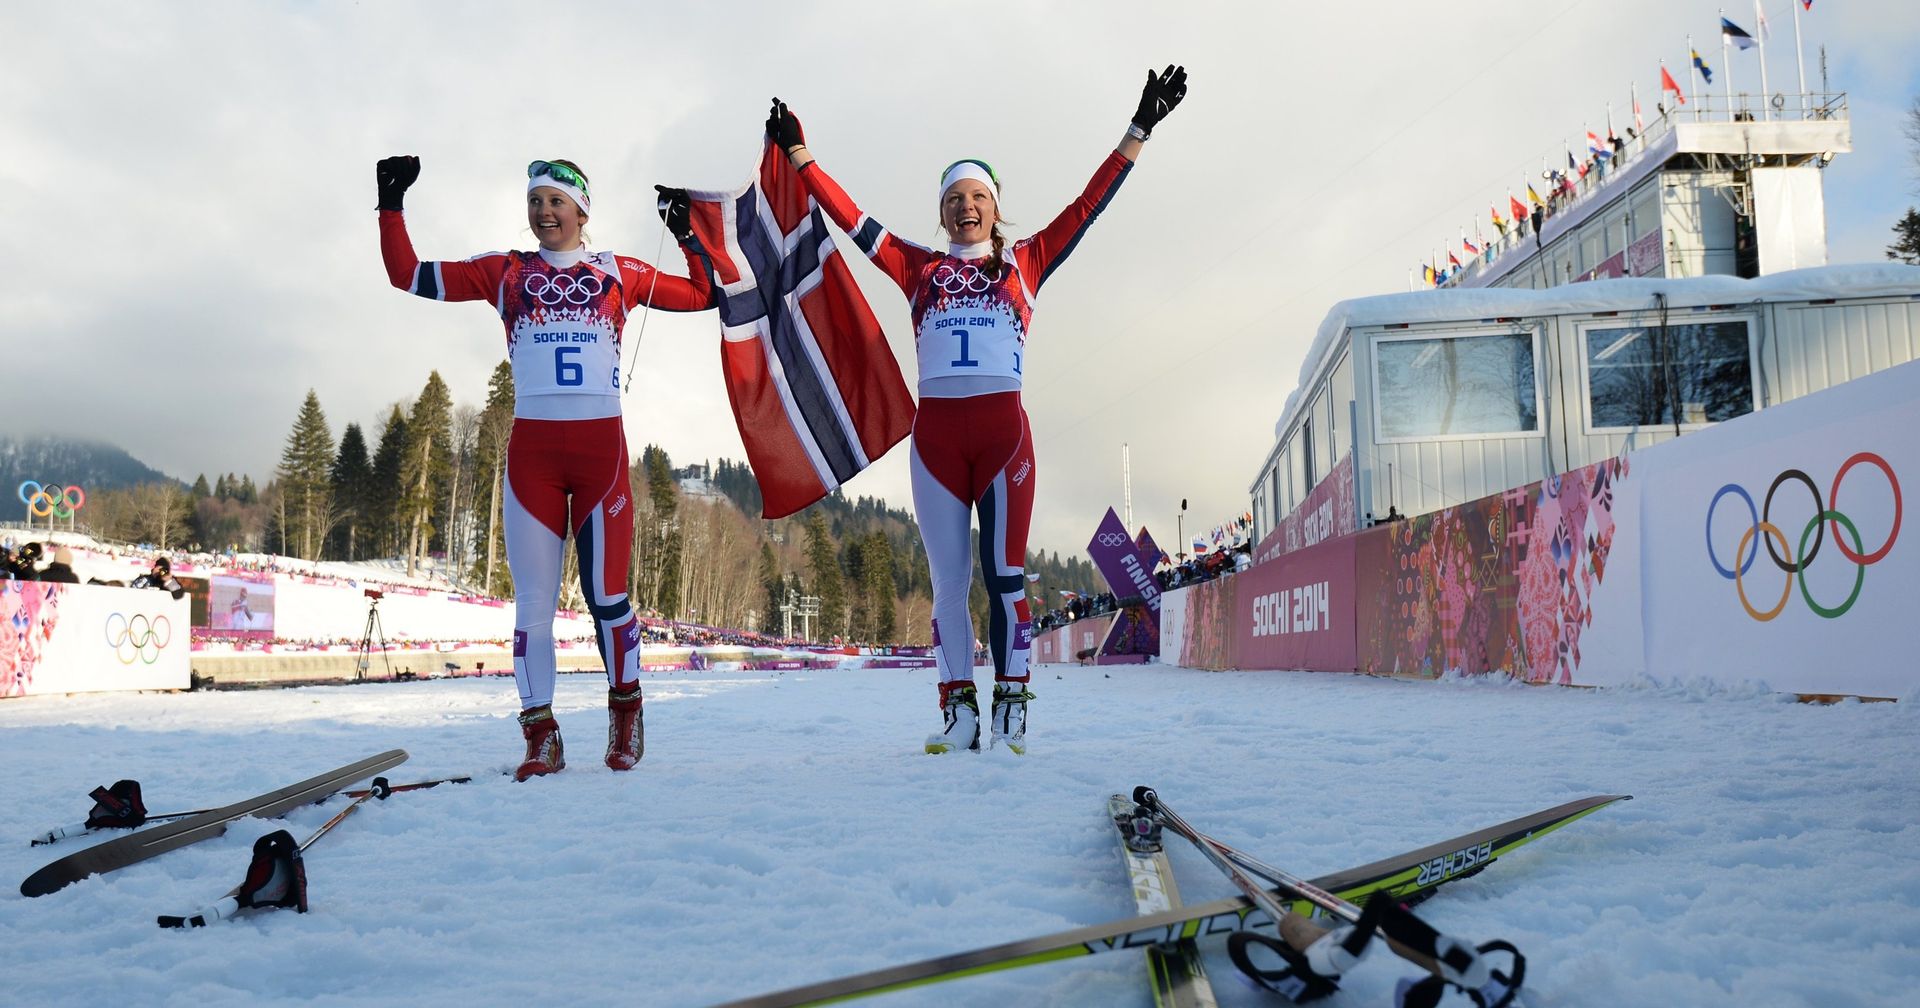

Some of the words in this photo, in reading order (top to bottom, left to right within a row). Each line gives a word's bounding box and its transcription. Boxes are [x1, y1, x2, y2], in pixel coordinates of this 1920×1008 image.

[533, 333, 568, 344] SOCHI
[571, 333, 597, 343] 2014
[934, 317, 966, 330] SOCHI
[969, 317, 995, 328] 2014
[554, 346, 583, 386] 6
[951, 330, 978, 367] 1
[1120, 553, 1161, 612] FINISH
[1252, 589, 1290, 637] SOCHI
[1293, 581, 1329, 633] 2014
[1416, 840, 1493, 886] FISCHER
